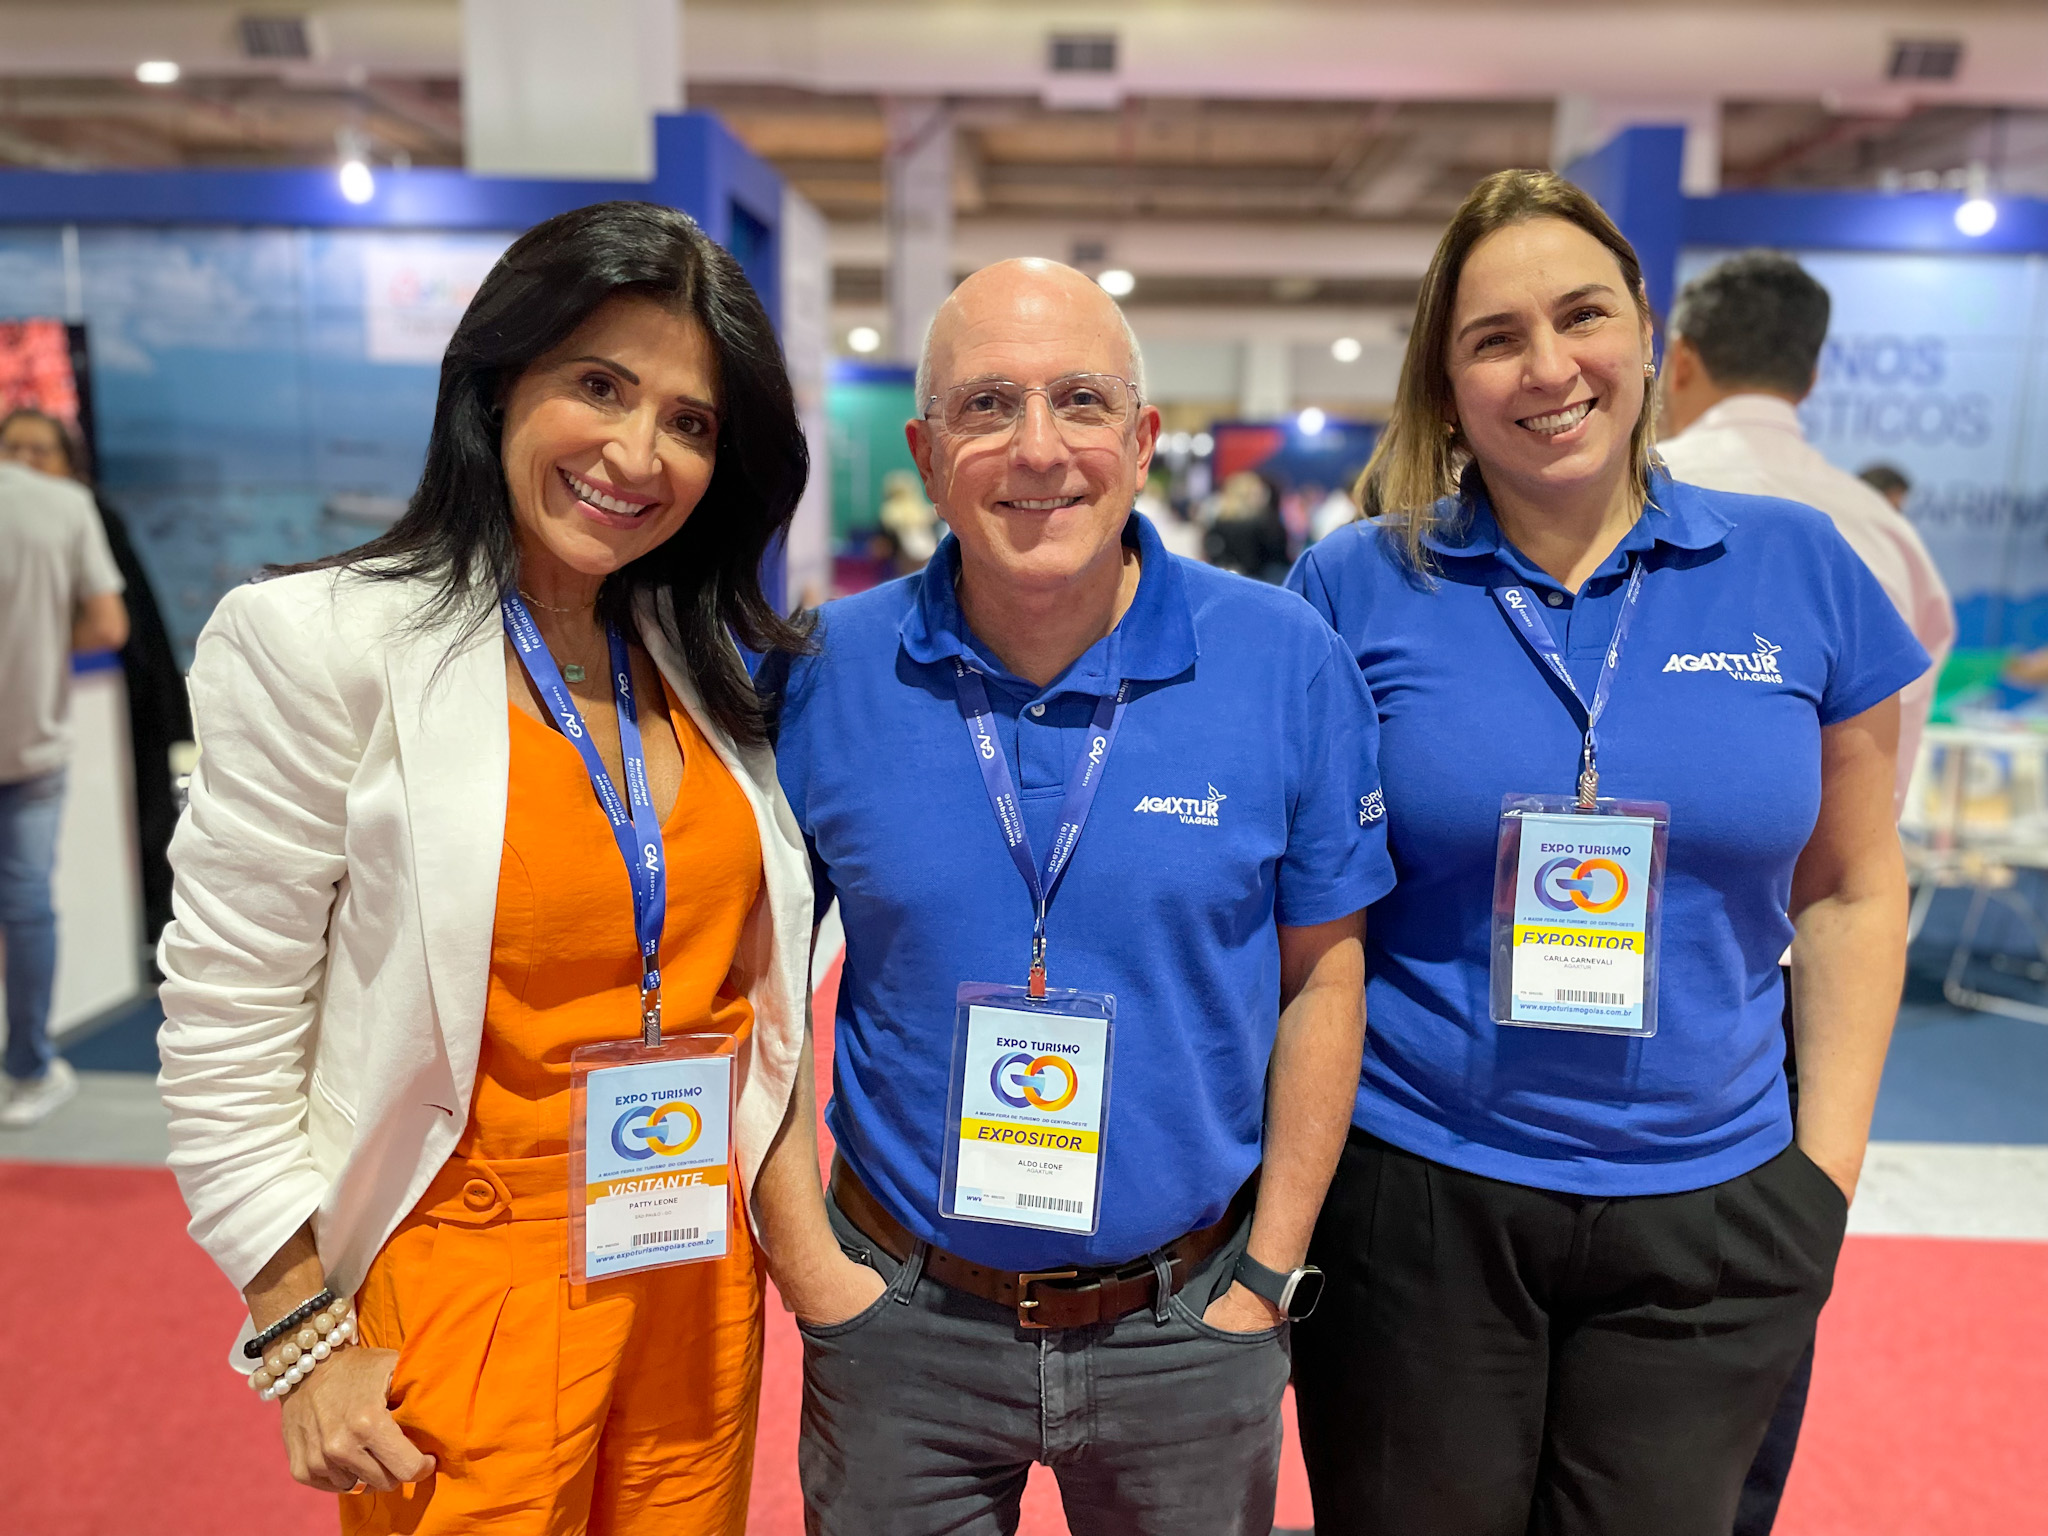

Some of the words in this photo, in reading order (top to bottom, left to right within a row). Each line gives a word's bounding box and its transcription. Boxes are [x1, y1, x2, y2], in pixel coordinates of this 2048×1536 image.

[1505, 590, 1527, 608] GAV
[503, 603, 532, 653] Multiplique
[512, 598, 542, 649] felicidade
[1662, 652, 1780, 673] AGAXTUR
[618, 672, 630, 700] GAV
[1729, 671, 1783, 684] VIAGENS
[552, 686, 568, 712] RESORTS
[560, 712, 582, 738] GAV
[977, 734, 995, 759] GAV
[1088, 736, 1106, 764] GAV
[628, 757, 641, 806] felicidade
[636, 758, 649, 807] Multiplique
[1082, 762, 1094, 787] RESORTS
[596, 774, 620, 826] Multiplique
[602, 773, 627, 824] felicidade
[1134, 796, 1219, 817] AGAXTUR
[996, 796, 1016, 847] Multiplique
[1005, 793, 1022, 843] felicidade
[1179, 815, 1219, 826] VIAGENS
[644, 843, 659, 872] GAV
[1048, 823, 1070, 872] felicidade
[1054, 824, 1078, 873] Multiplique
[1541, 843, 1574, 853] EXPO
[1578, 845, 1631, 856] TURISMO
[1523, 932, 1634, 950] EXPOSITOR
[1571, 957, 1613, 965] CARNEVALI
[1520, 1003, 1632, 1016] www.expoturismogoias.com.br
[997, 1037, 1027, 1049] EXPO
[1031, 1041, 1080, 1054] TURISMO
[616, 1093, 648, 1106] EXPO
[651, 1086, 702, 1100] TURISMO
[978, 1126, 1082, 1150] EXPOSITOR
[1018, 1160, 1038, 1168] ALDO
[1040, 1162, 1063, 1170] LEONE
[608, 1172, 703, 1198] VISITANTE
[629, 1201, 652, 1209] PATTY
[654, 1197, 678, 1206] LEONE
[596, 1238, 714, 1263] www.expoturismogoias.com.br
